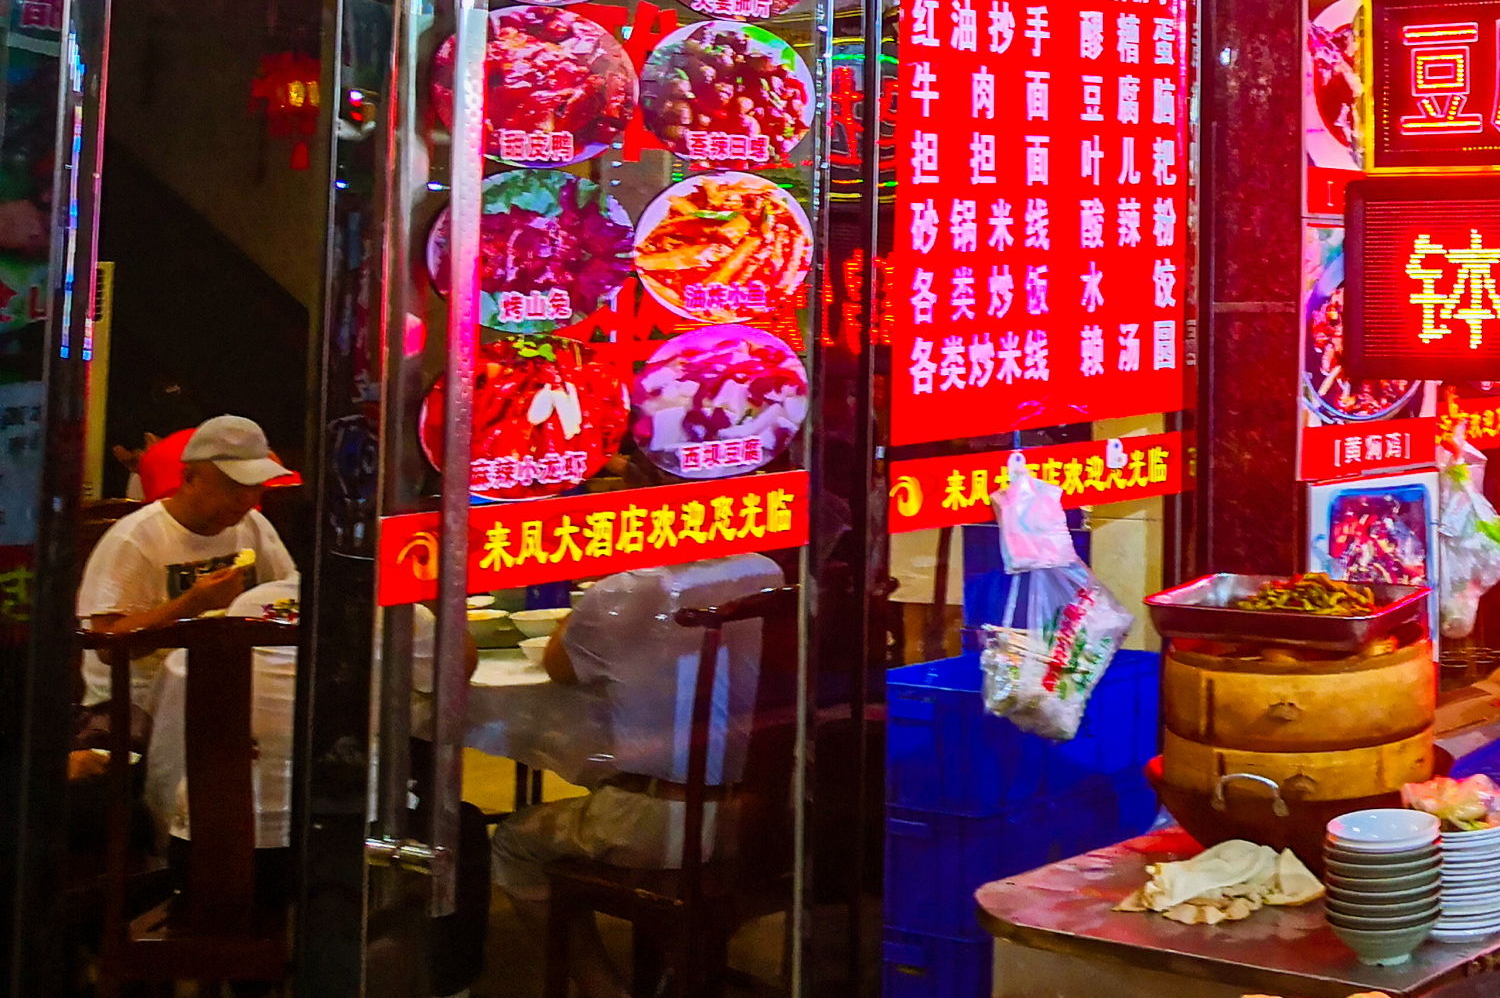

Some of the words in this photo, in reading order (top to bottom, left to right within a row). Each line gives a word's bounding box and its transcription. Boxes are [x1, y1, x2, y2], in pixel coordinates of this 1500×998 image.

[1079, 11, 1176, 65] 醪糟蛋
[911, 62, 1050, 121] 牛肉面
[1080, 74, 1175, 125] 豆腐脑
[500, 130, 574, 162] 甜皮鸭
[911, 130, 1050, 186] 担担面
[1080, 135, 1177, 186] 叶儿粑
[911, 198, 1050, 254] 砂锅米线
[1080, 197, 1177, 249] 酸辣粉
[911, 264, 1049, 324] 各类炒饭
[1080, 258, 1177, 313] 水饺
[909, 330, 1050, 395] 各类炒米线
[1080, 320, 1177, 377] 赖汤圆
[478, 488, 795, 573] 来凤大酒店欢迎您光临
